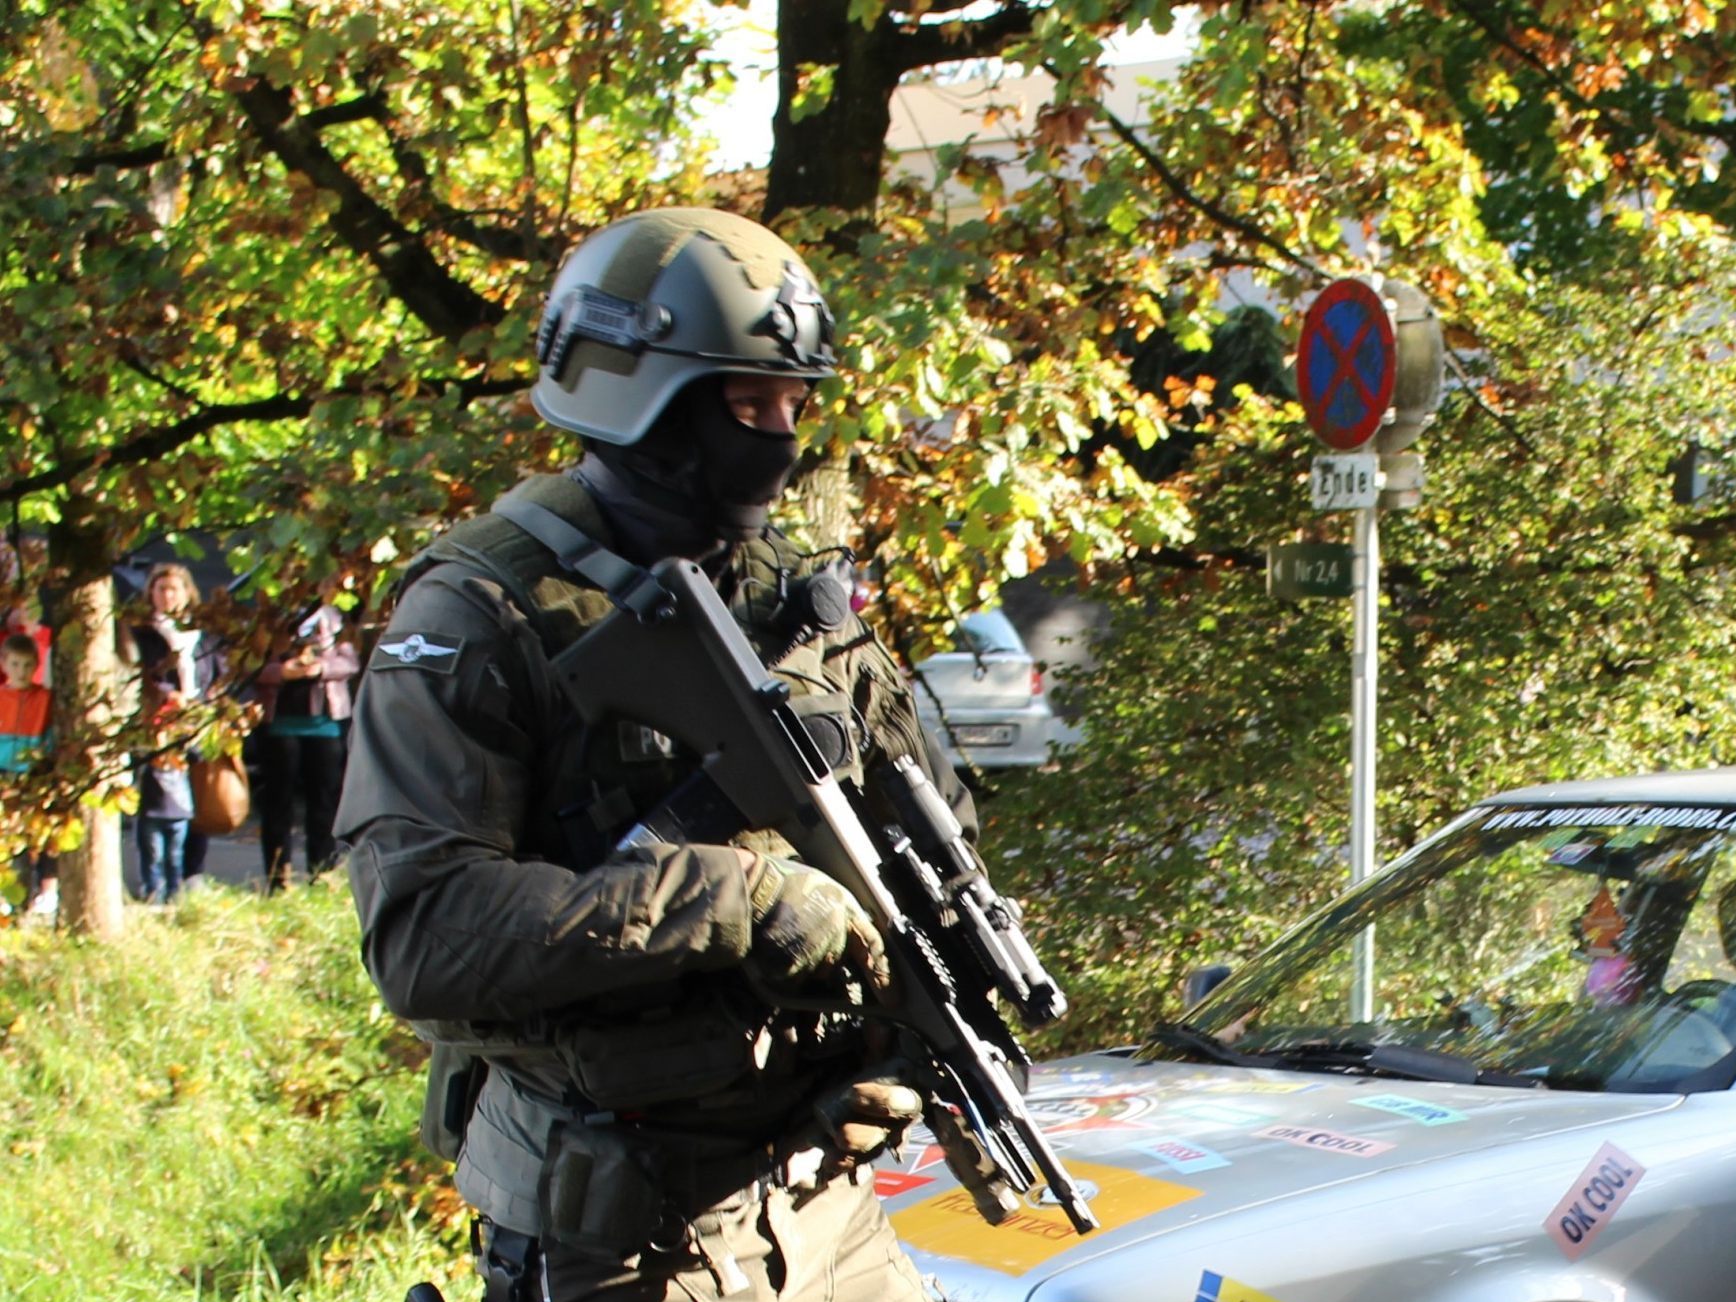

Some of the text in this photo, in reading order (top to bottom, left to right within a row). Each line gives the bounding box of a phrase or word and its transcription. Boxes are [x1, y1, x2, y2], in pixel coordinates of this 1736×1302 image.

[1319, 464, 1367, 496] Ende
[1268, 1127, 1375, 1154] OK COOL
[1560, 1157, 1634, 1245] OK COOL
